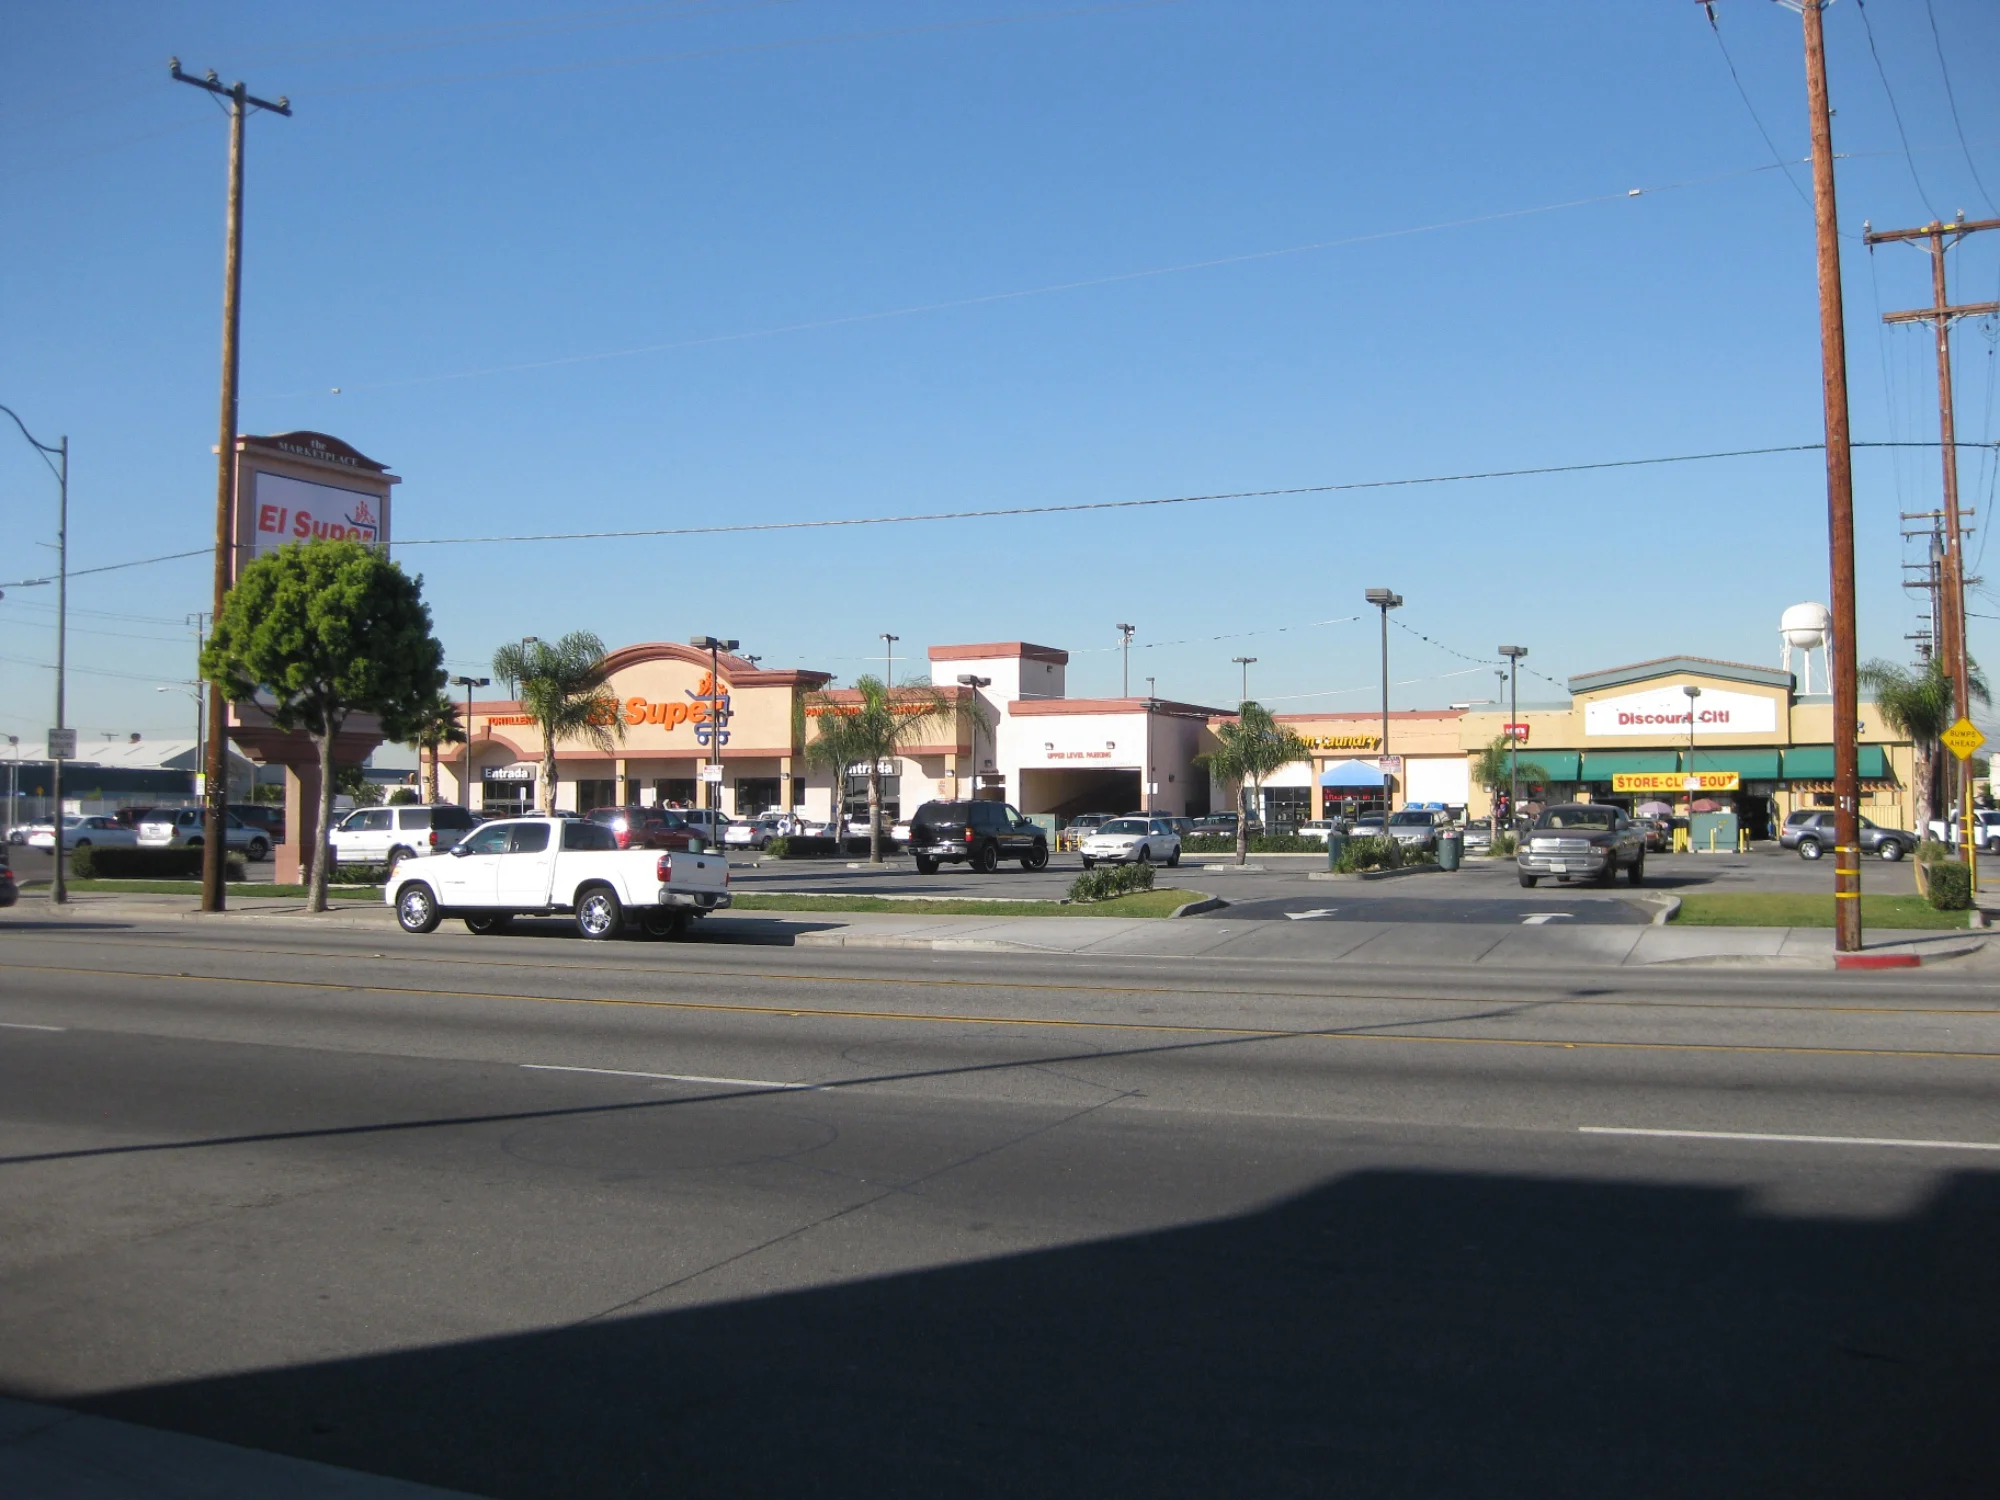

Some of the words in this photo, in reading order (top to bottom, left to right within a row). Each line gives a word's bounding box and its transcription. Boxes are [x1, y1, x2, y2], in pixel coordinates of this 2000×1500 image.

[310, 439, 327, 451] the
[278, 441, 359, 468] MARKETPLACE
[258, 503, 288, 534] El
[624, 697, 724, 731] Super
[1618, 711, 1693, 726] Discount
[1950, 729, 1976, 738] BUMPS
[1318, 734, 1381, 750] Laundry
[1949, 739, 1976, 748] AHEAD
[1047, 752, 1065, 760] UPPER
[1086, 751, 1112, 759] PARKING
[485, 767, 528, 779] Entrada
[848, 761, 893, 774] ntrada
[1617, 775, 1735, 789] STORE-CLEOUT
